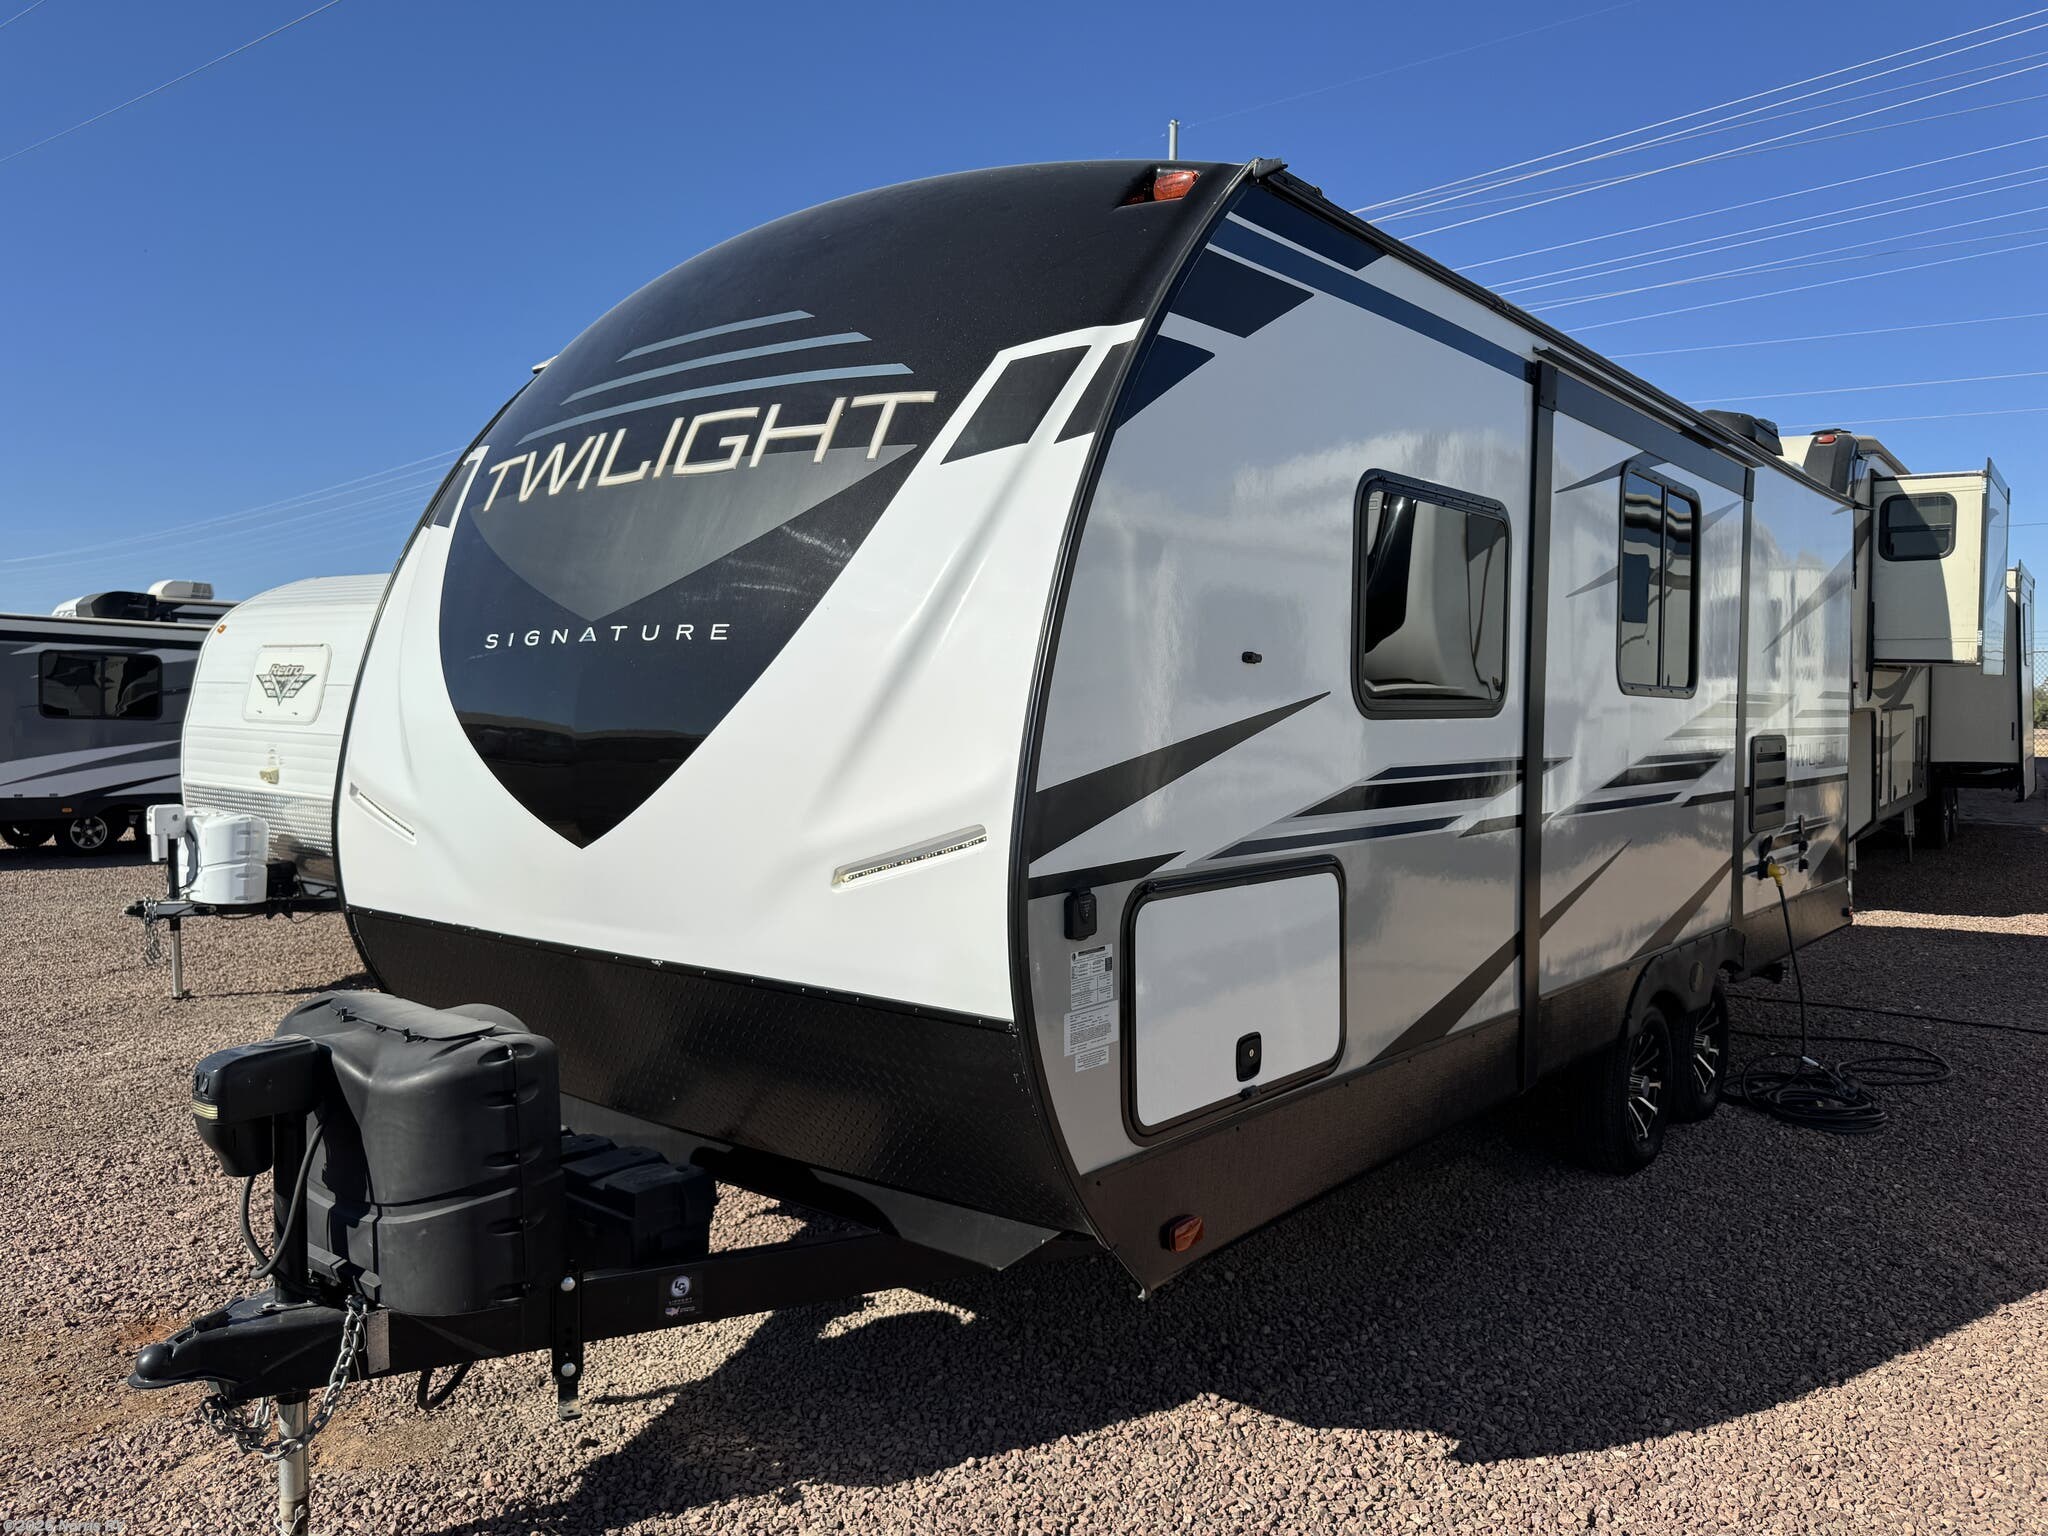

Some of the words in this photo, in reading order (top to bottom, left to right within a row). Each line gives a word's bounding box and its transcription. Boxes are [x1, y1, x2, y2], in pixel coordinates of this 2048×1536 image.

[484, 391, 937, 511] TWILIGHT
[485, 623, 730, 649] SIGNATURE
[270, 663, 304, 677] Retro
